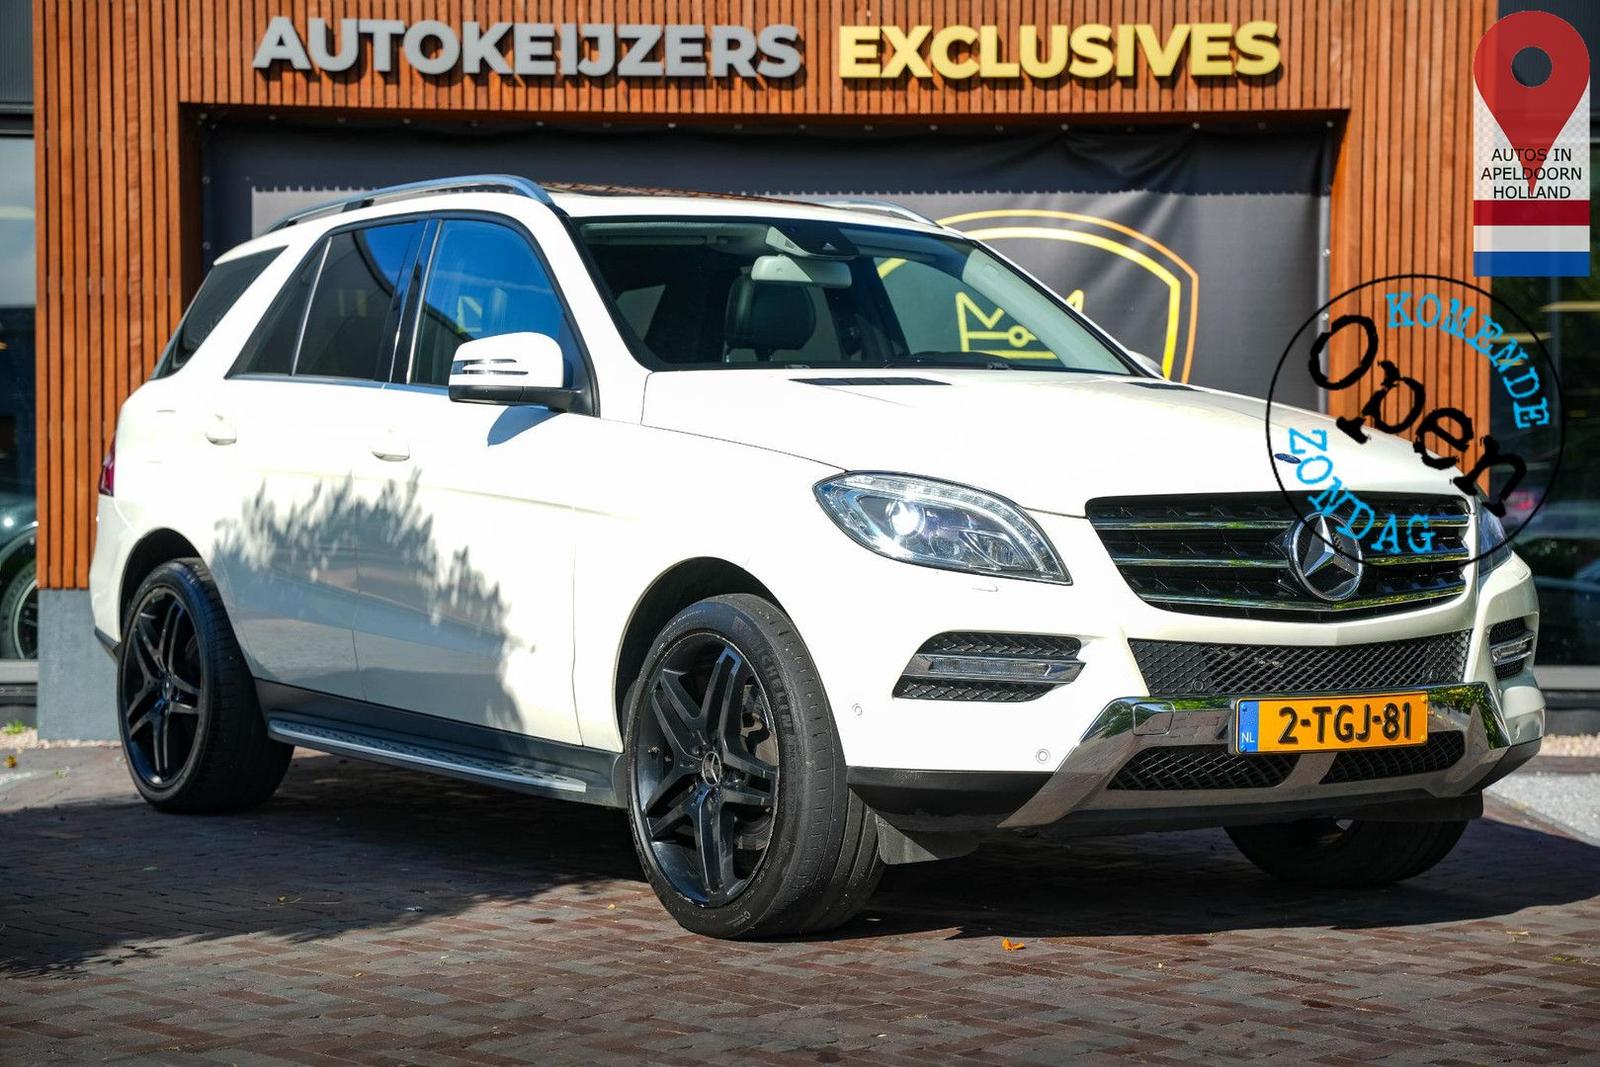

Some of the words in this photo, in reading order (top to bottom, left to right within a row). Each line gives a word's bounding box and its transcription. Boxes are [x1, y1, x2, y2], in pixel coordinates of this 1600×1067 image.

[252, 16, 802, 78] AUTOKEIJZERS
[839, 21, 1281, 79] EXCLUSIVES
[1241, 732, 1255, 743] NL
[1278, 702, 1411, 744] 2-TGJ-81
